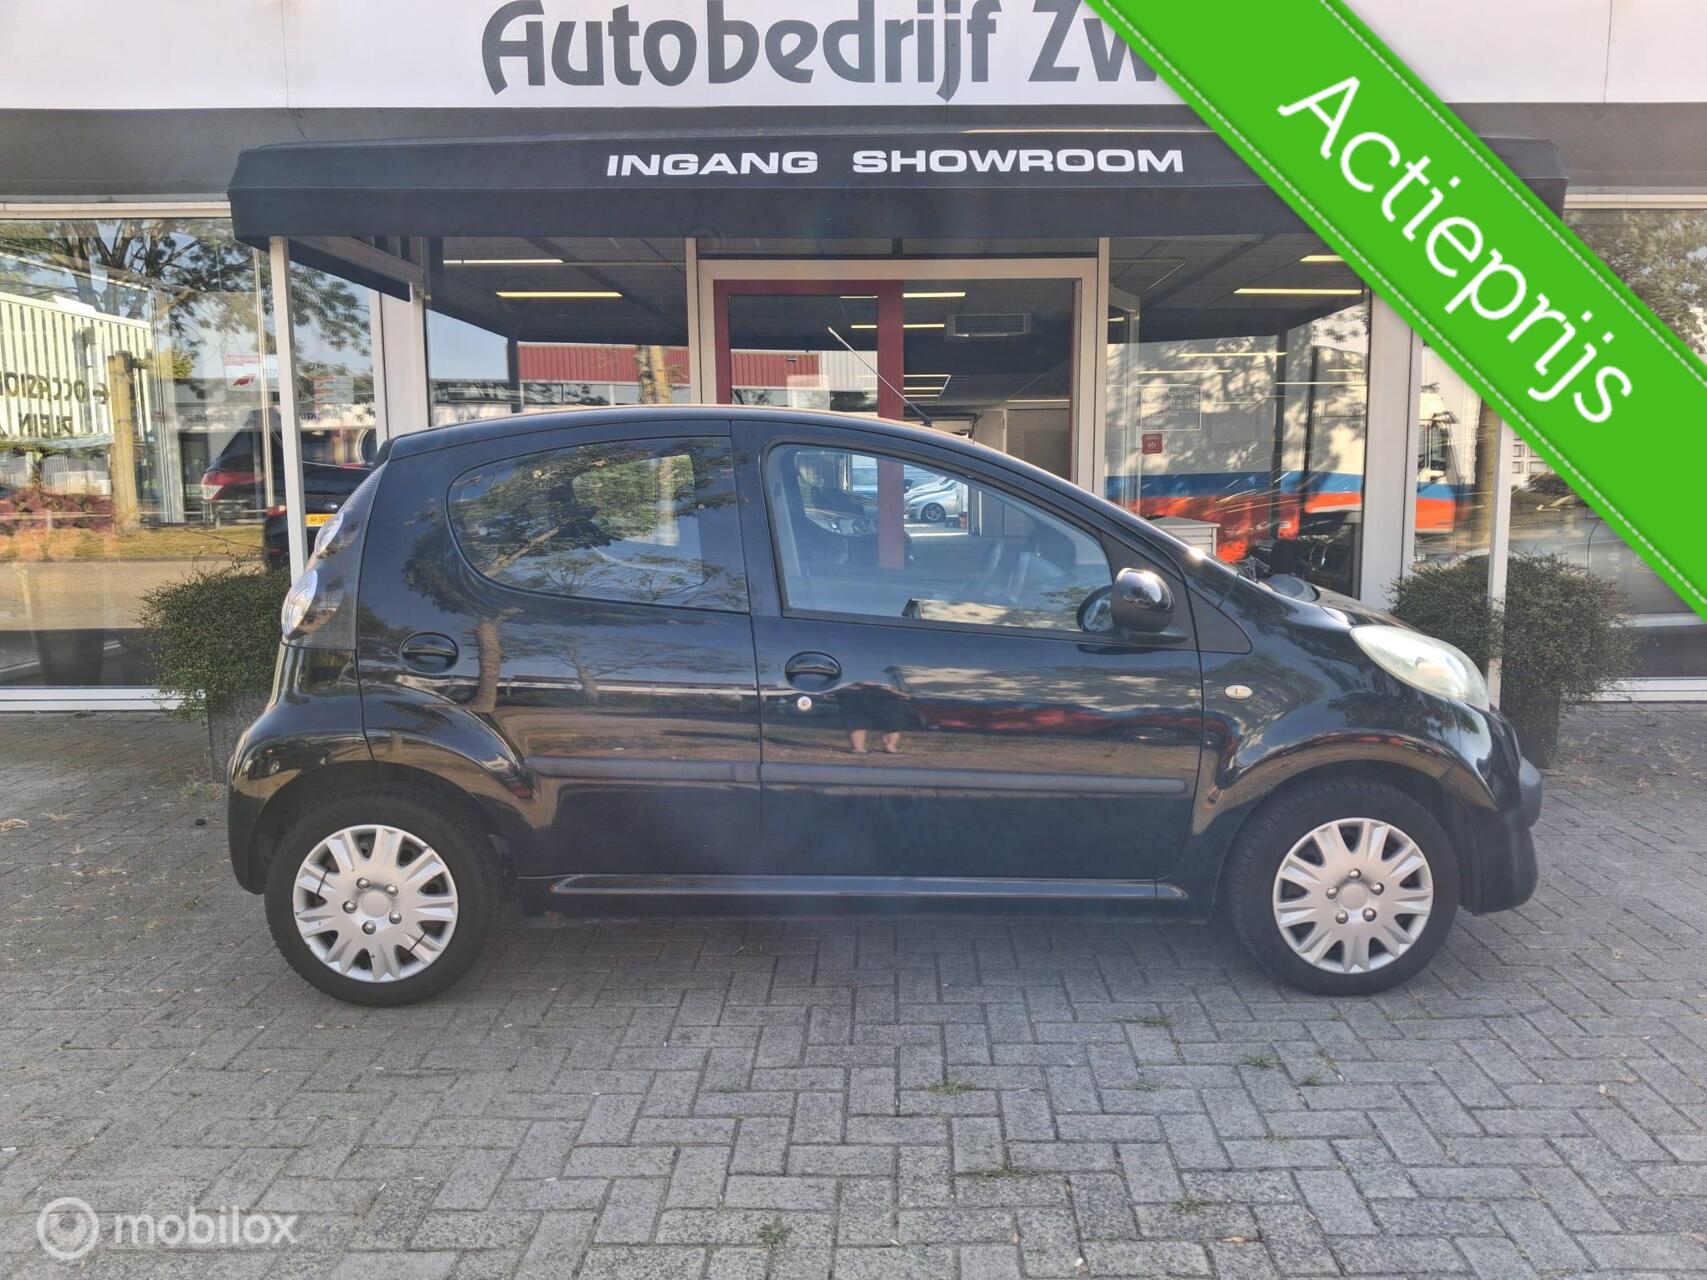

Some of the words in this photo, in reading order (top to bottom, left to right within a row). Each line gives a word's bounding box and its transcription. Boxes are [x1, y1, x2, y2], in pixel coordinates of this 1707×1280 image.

[482, 0, 1001, 102] Autobedrijf
[606, 151, 818, 177] INGANG
[852, 148, 1184, 173] SHOWROOM
